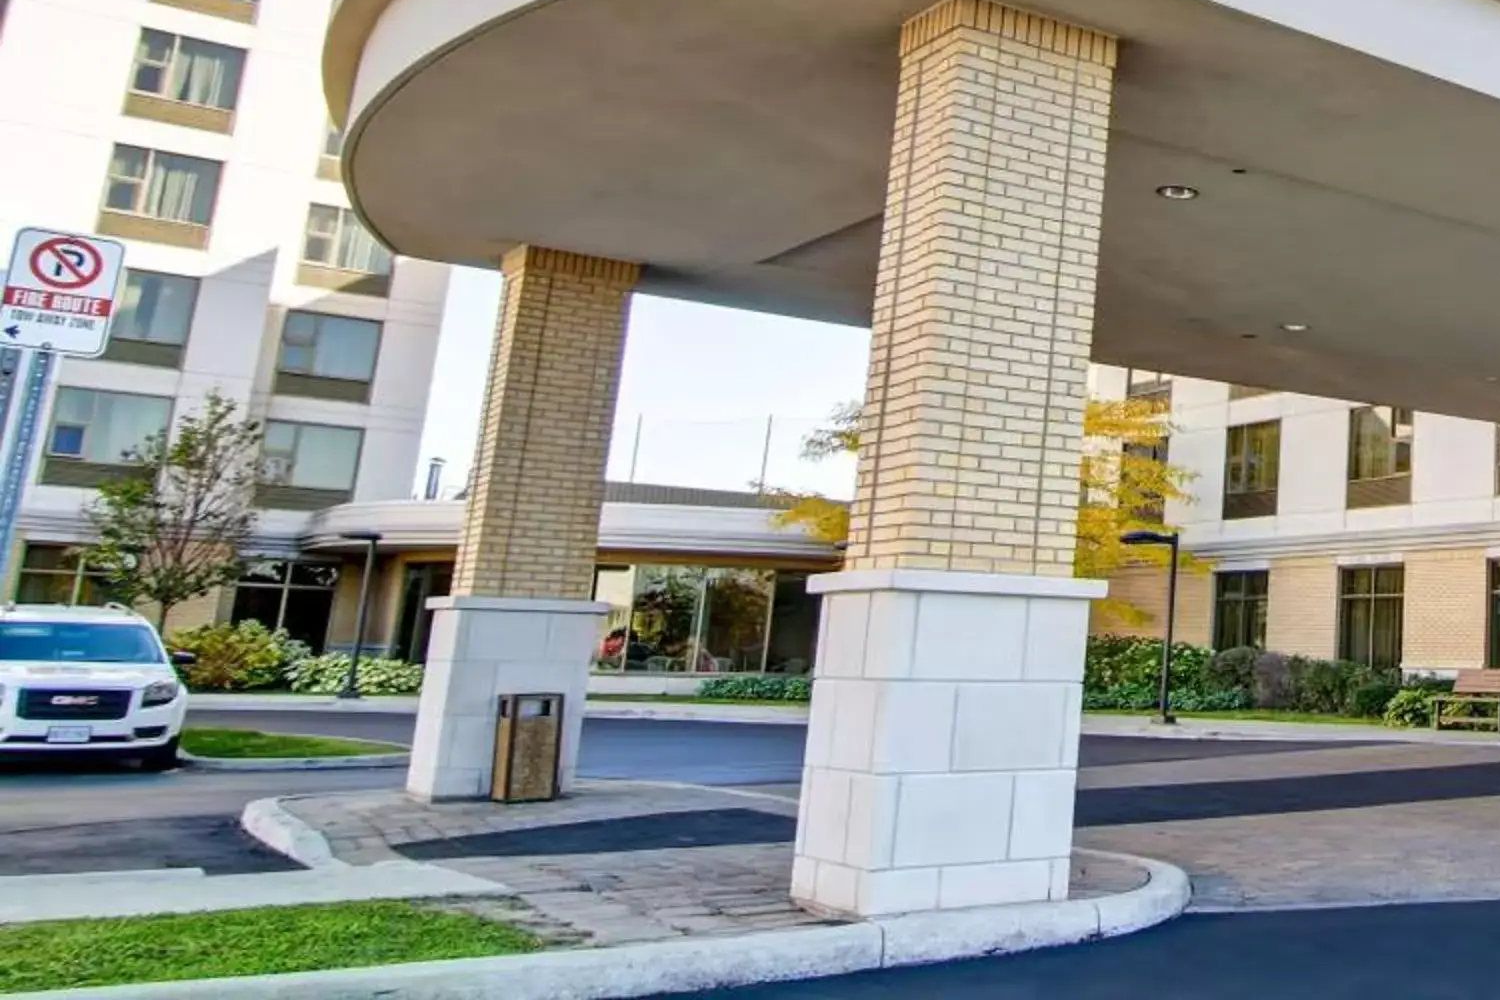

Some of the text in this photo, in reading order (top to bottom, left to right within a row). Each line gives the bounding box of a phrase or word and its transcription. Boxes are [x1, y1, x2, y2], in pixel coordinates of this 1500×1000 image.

[12, 289, 101, 315] FIRE ROUTE
[51, 695, 98, 705] GMC
